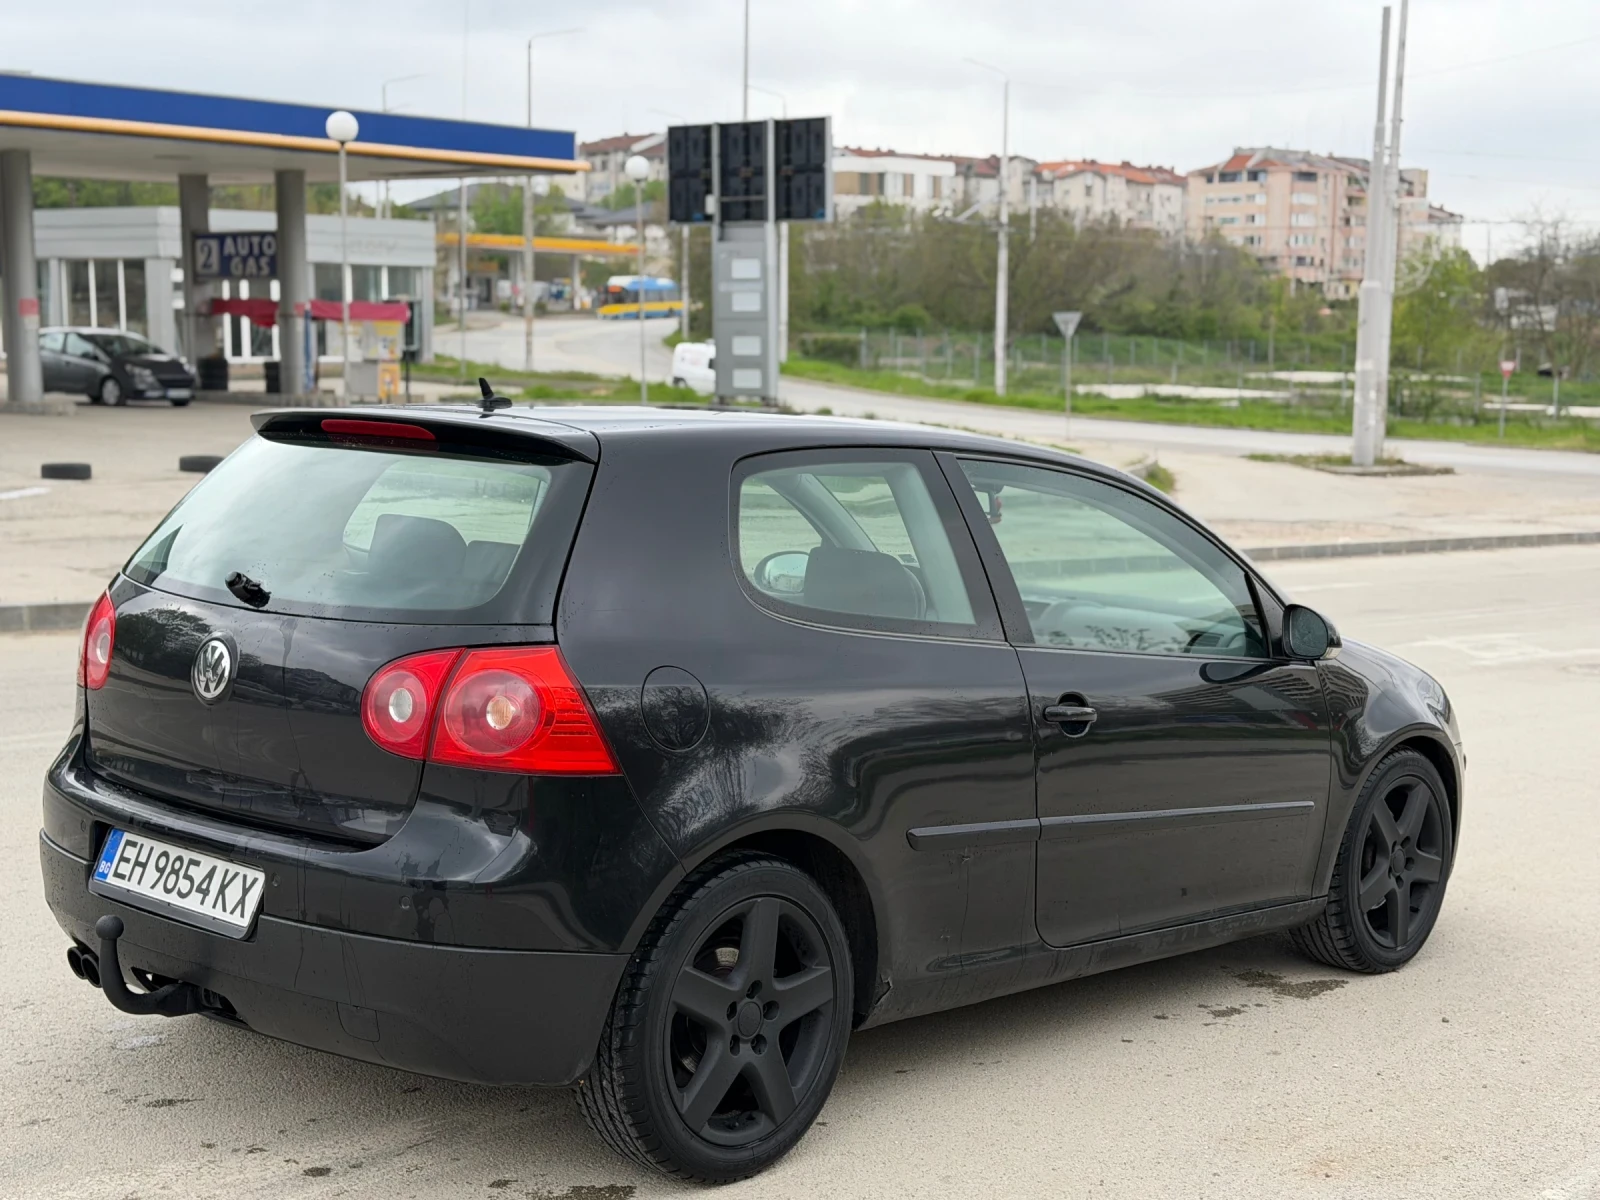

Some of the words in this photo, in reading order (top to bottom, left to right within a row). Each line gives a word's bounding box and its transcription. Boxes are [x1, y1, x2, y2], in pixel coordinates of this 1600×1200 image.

[200, 243, 213, 269] 2
[223, 235, 276, 256] AUTO
[230, 256, 270, 277] GAS
[98, 861, 112, 874] BG
